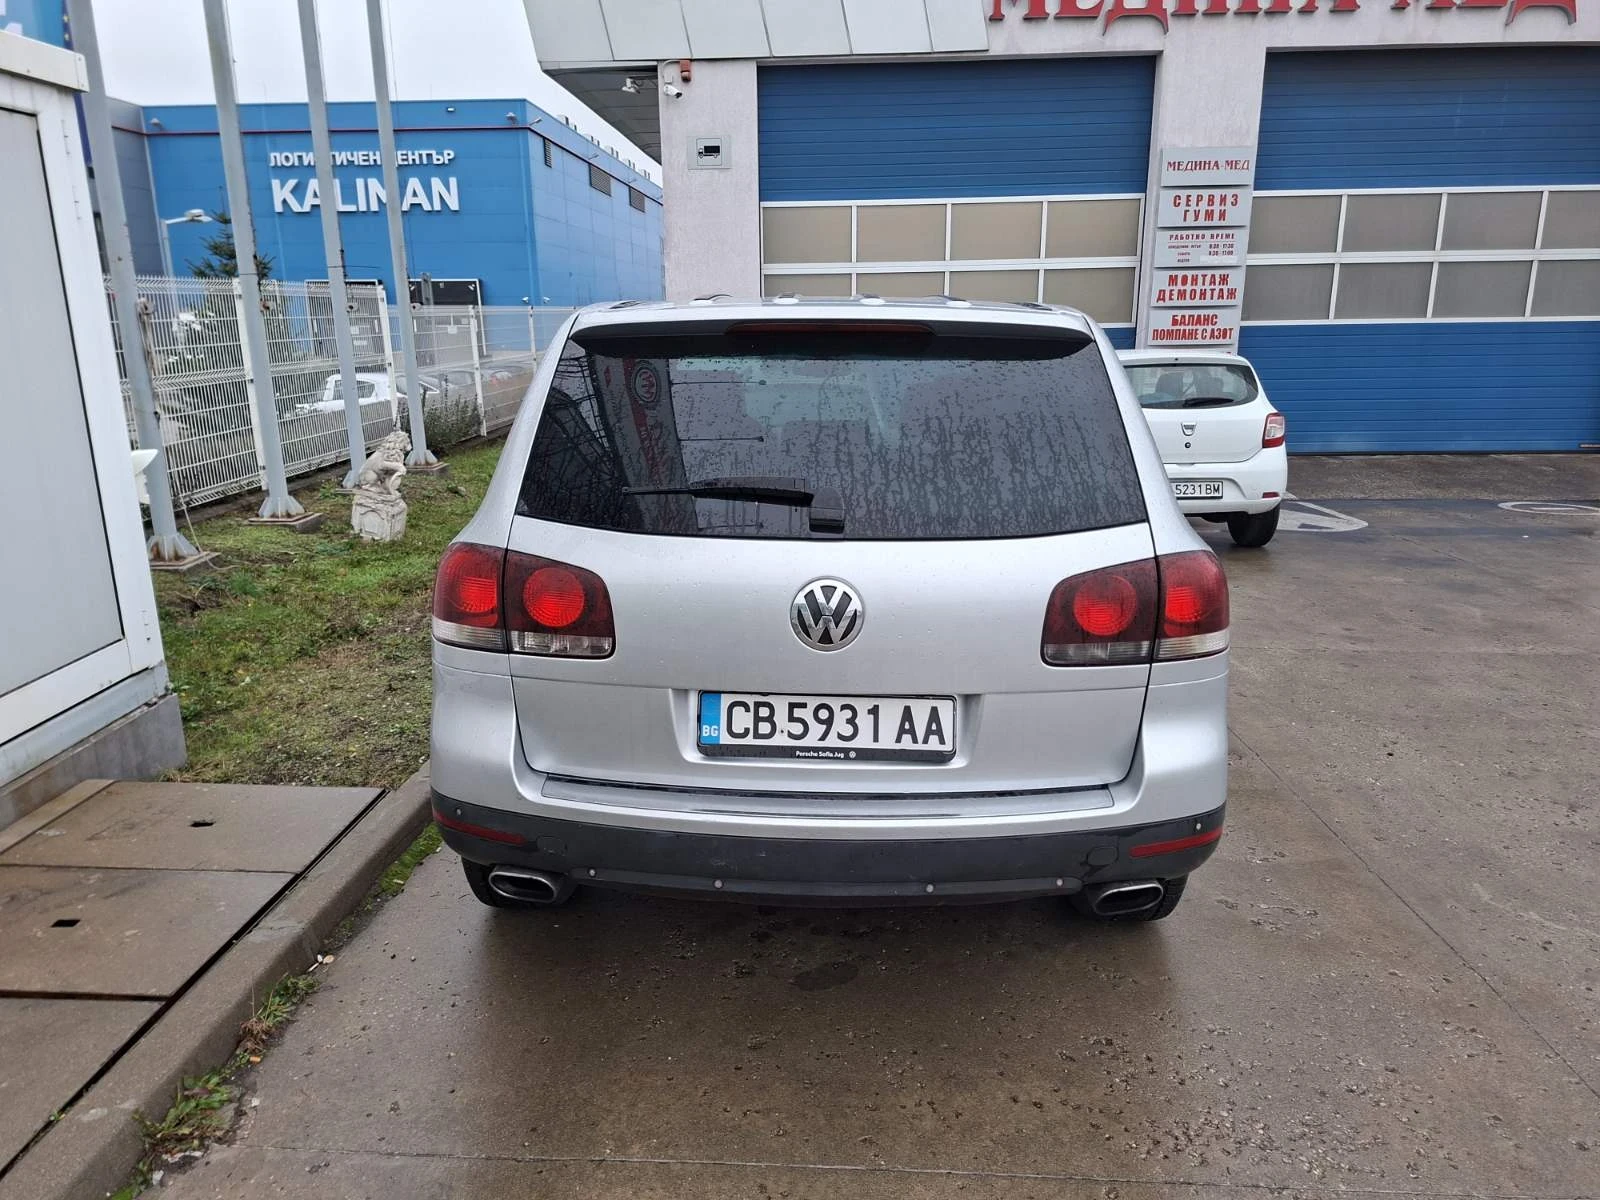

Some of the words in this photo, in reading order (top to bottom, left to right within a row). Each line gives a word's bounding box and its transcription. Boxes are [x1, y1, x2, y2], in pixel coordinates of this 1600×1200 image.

[269, 150, 381, 167] ЛОГИТИЧЕН
[395, 149, 456, 168] ЕНТЪР
[1173, 193, 1239, 207] СЕРВИЗ
[1183, 208, 1227, 222] ГУМИ
[1169, 233, 1206, 241] РАБОТНО
[1168, 273, 1229, 287] МОНТАЖ
[1156, 288, 1237, 303] ДЕМОНТАЖ
[1171, 313, 1218, 327] БАЛАНС
[1152, 328, 1199, 341] ПОМПАНЕ
[1201, 328, 1208, 340] С
[1209, 327, 1234, 340] АЗОТ
[1175, 484, 1202, 495] 5231
[1205, 484, 1220, 495] BM
[726, 700, 778, 740] CB
[787, 701, 880, 743] 5931
[895, 704, 947, 745] AA
[702, 724, 719, 738] BG
